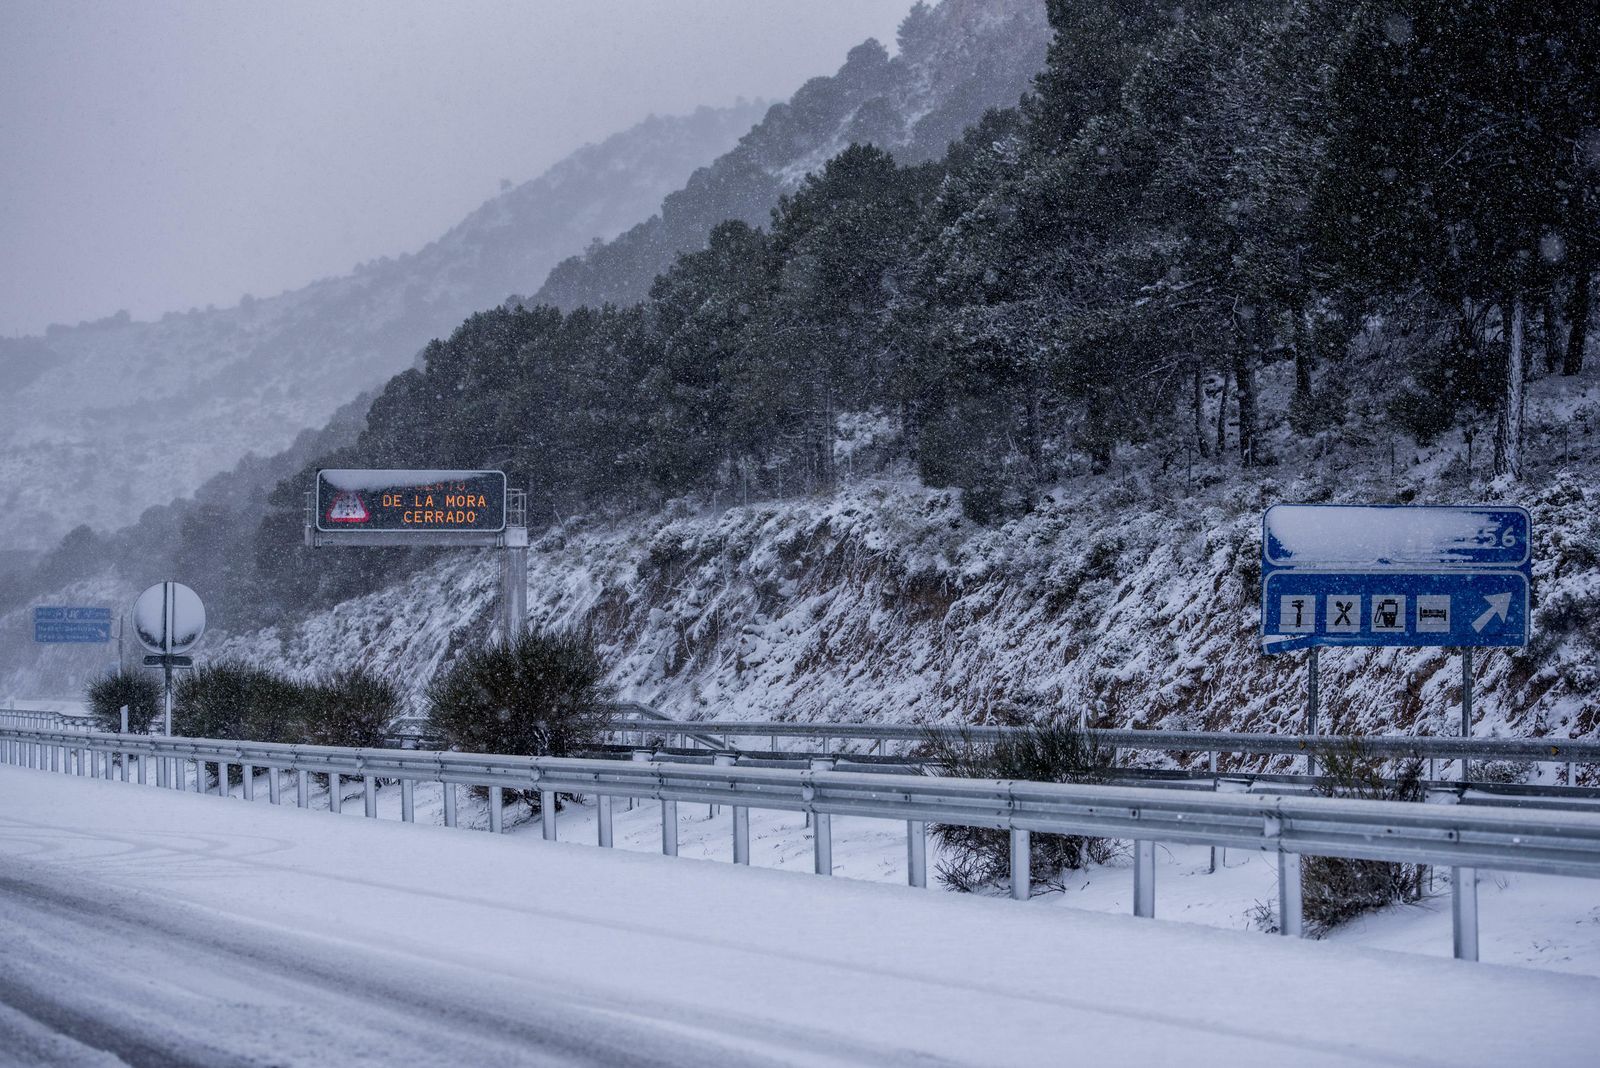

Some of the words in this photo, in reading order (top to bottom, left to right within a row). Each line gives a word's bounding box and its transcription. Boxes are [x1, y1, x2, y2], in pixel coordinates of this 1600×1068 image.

[383, 495, 402, 507] DE
[415, 495, 434, 507] LA
[446, 495, 486, 507] MORA
[403, 510, 476, 523] CERRADO
